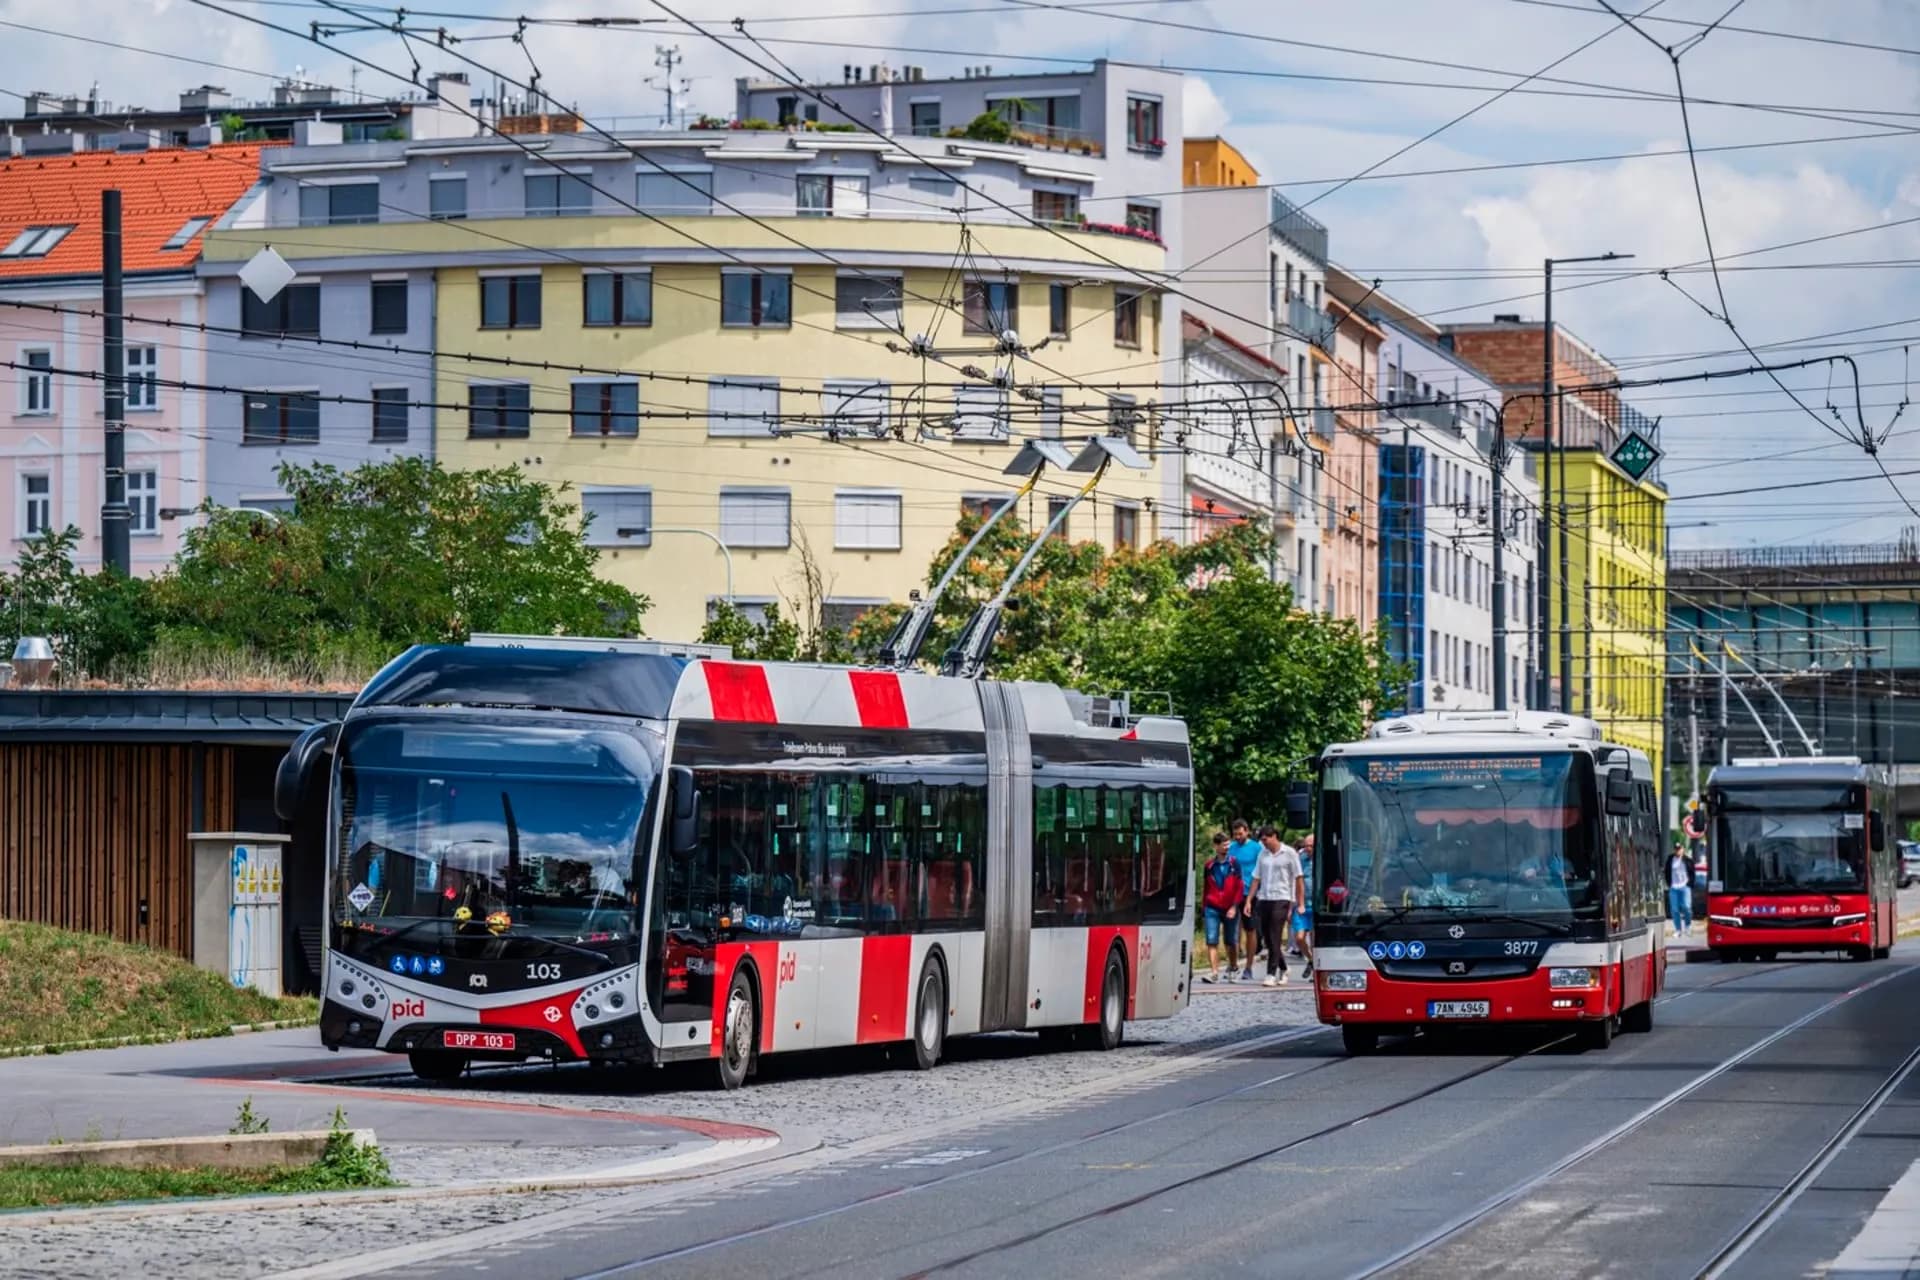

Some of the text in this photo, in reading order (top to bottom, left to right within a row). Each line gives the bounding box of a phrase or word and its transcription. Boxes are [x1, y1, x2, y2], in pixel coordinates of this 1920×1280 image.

[1504, 941, 1538, 955] 3877
[526, 964, 561, 980] 103
[779, 952, 796, 989] pid
[392, 998, 424, 1020] pid
[1436, 1003, 1485, 1013] 7AN 4946
[456, 1034, 503, 1047] DPP 103
